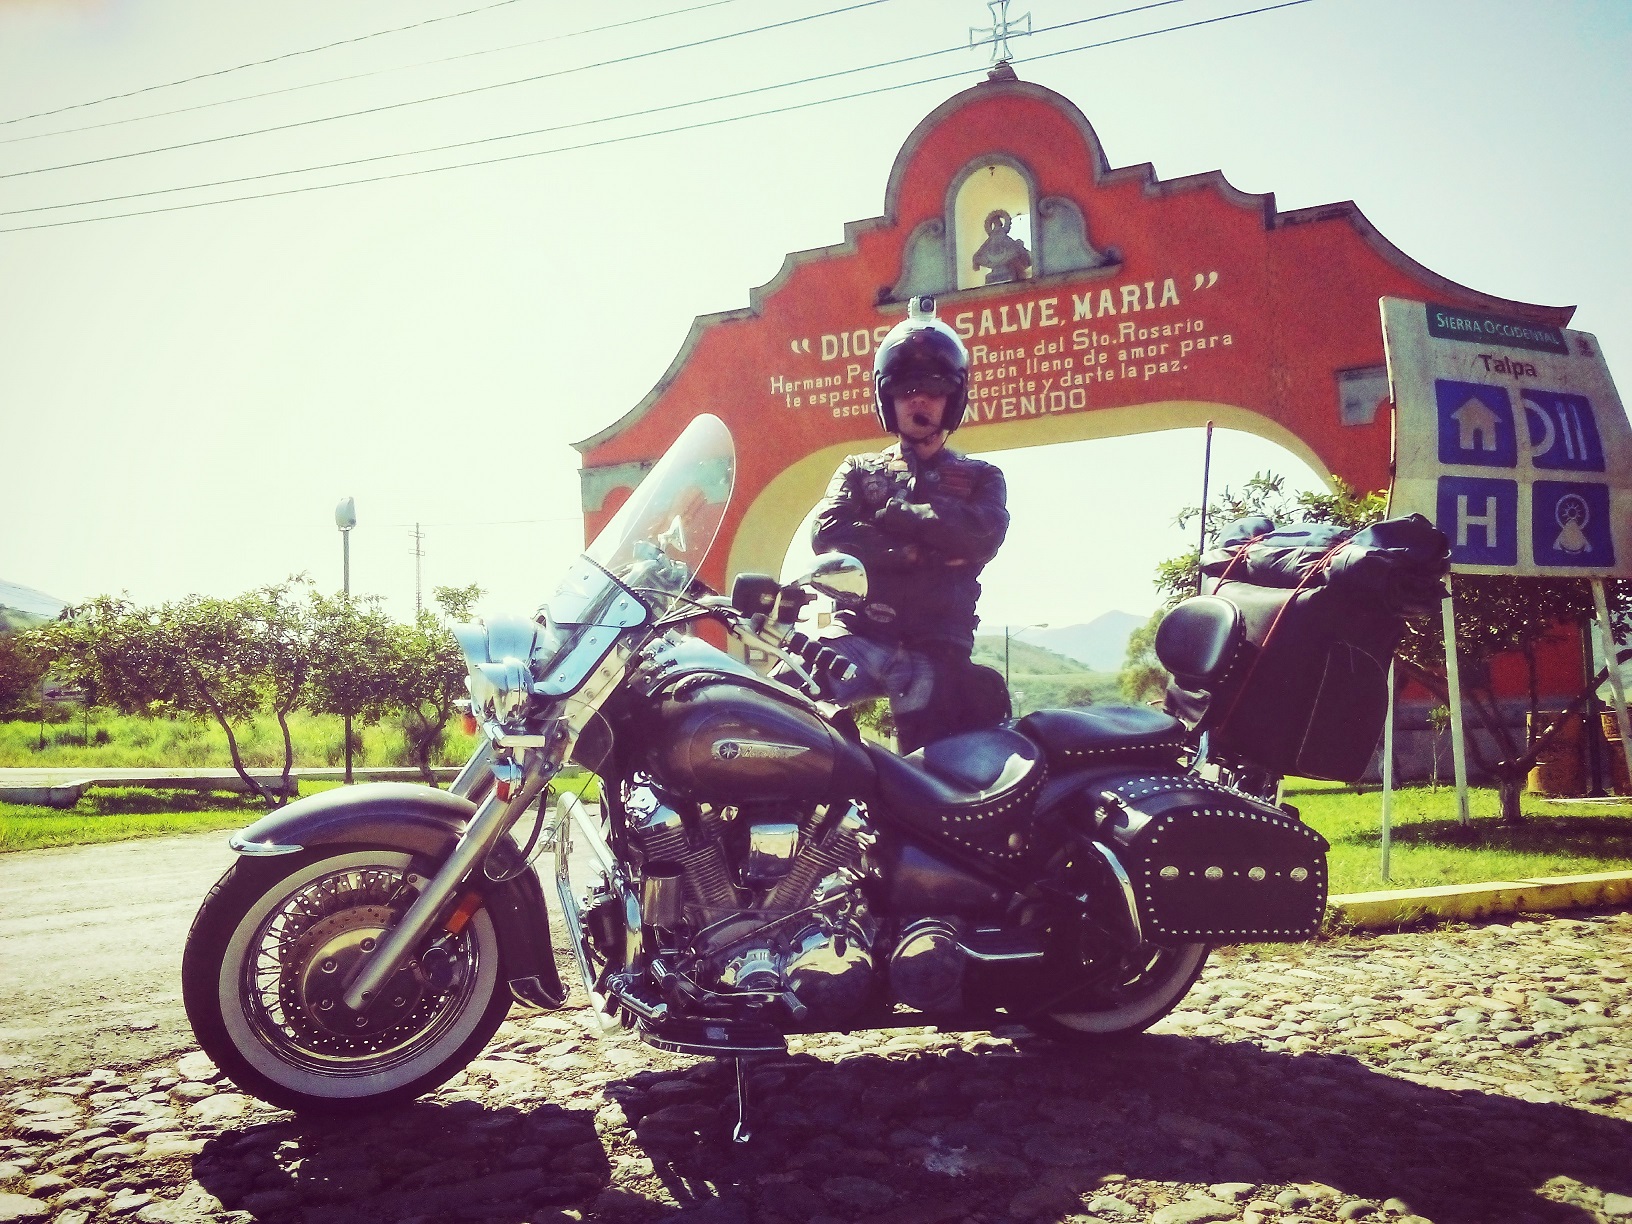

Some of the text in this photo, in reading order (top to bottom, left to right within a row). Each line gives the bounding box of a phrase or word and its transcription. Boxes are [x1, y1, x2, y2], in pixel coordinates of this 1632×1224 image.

[955, 297, 1066, 340] SALVE,
[1072, 278, 1180, 322] MARIA
[770, 375, 841, 395] Hermano
[972, 344, 1026, 366] Reina
[1034, 337, 1064, 356] del
[786, 393, 801, 408] te
[809, 388, 870, 407] espera
[1026, 357, 1073, 375] lleno
[1083, 349, 1108, 366] de
[1118, 343, 1169, 361] amor
[1180, 334, 1233, 357] para
[967, 377, 1036, 400] decirte
[1041, 378, 1053, 395] y
[1060, 367, 1115, 388] darte
[1121, 362, 1137, 379] la
[1144, 359, 1188, 381] paz.
[1478, 353, 1538, 380] Talpa
[964, 388, 1086, 423] NVENIDO
